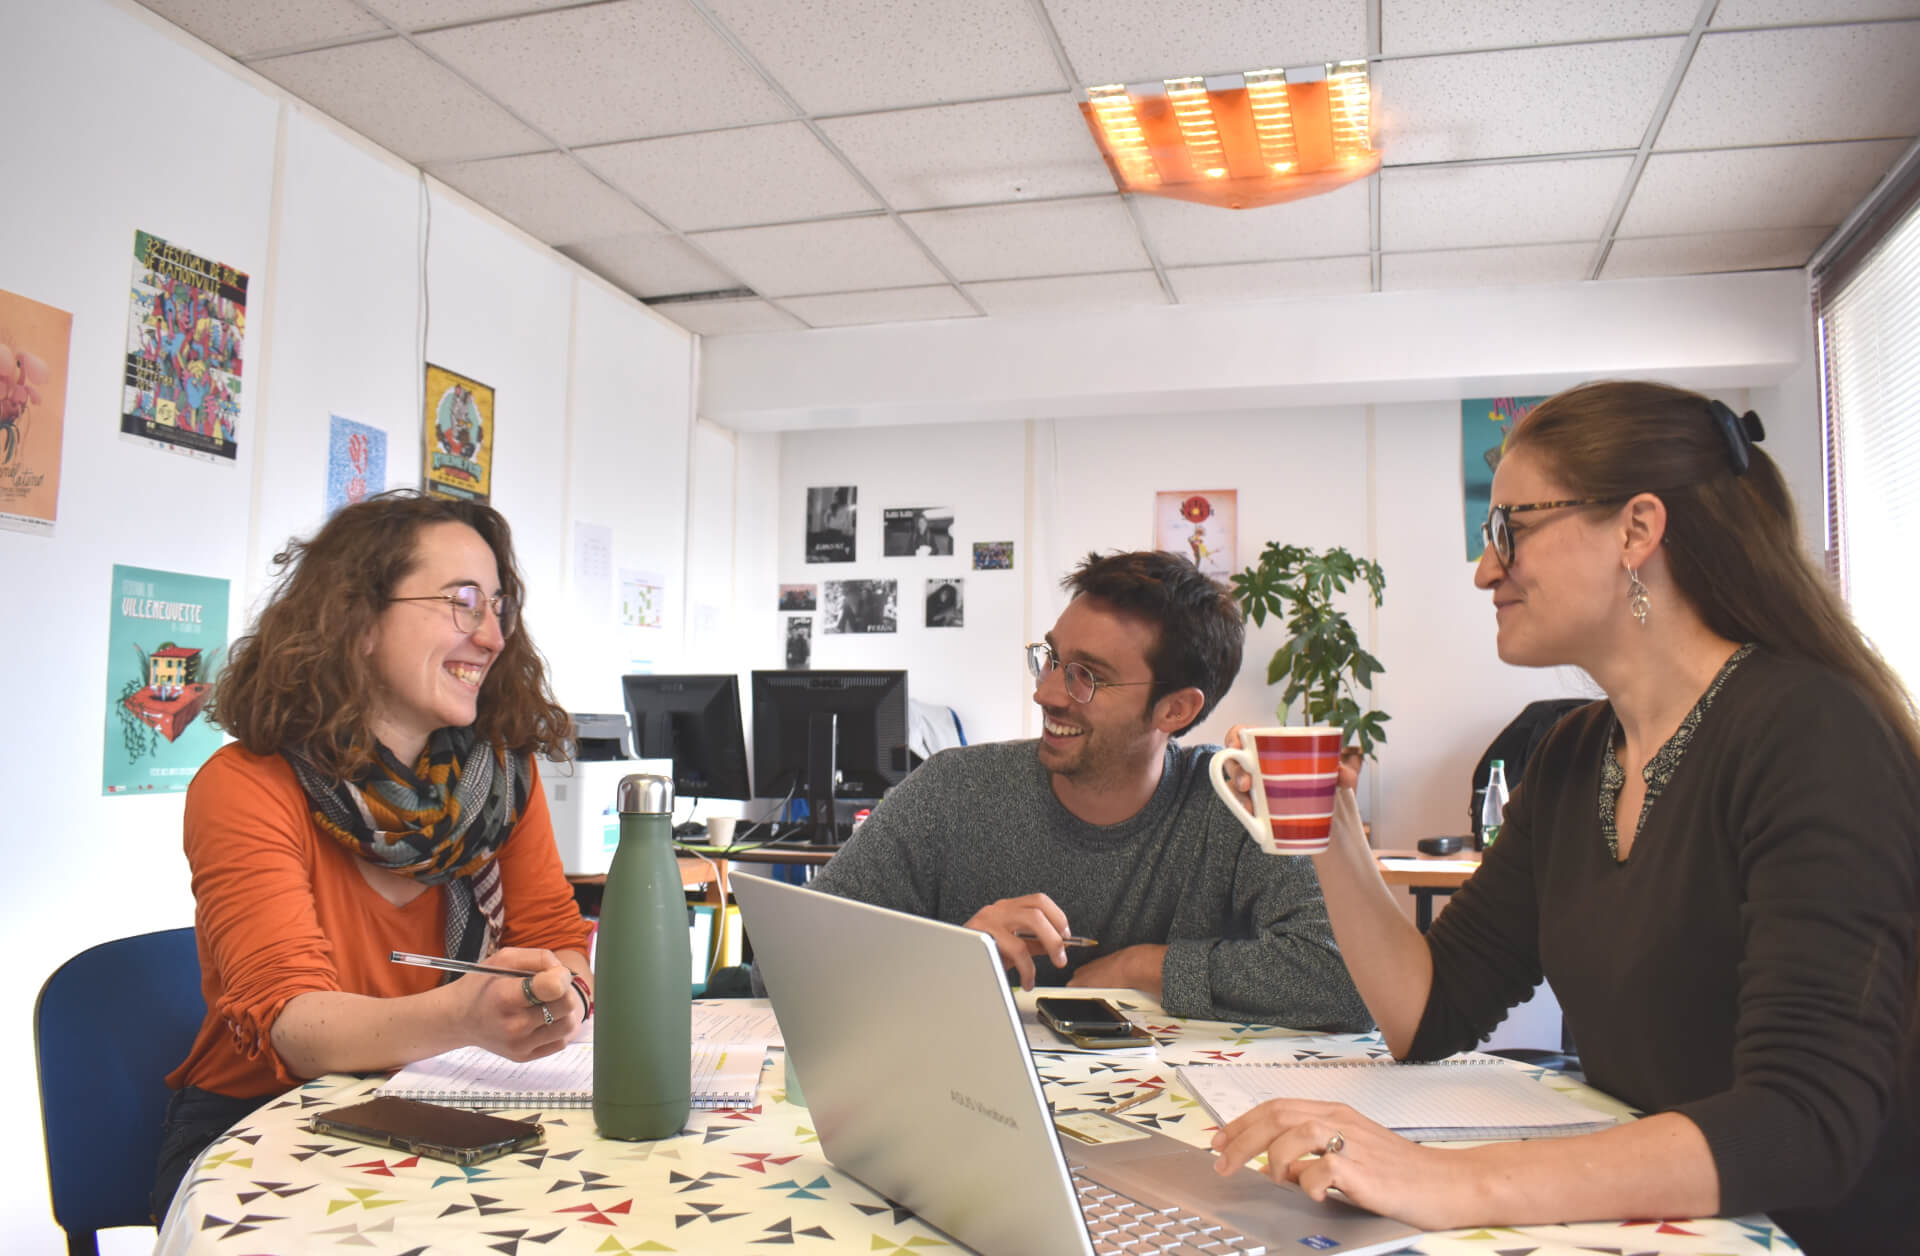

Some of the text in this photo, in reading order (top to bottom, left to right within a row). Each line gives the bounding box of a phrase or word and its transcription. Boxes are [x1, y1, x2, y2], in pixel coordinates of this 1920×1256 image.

[163, 245, 205, 276] FESTIVAL
[158, 261, 221, 294] RAMONVILLE
[123, 597, 203, 624] VILLENEUVETTE
